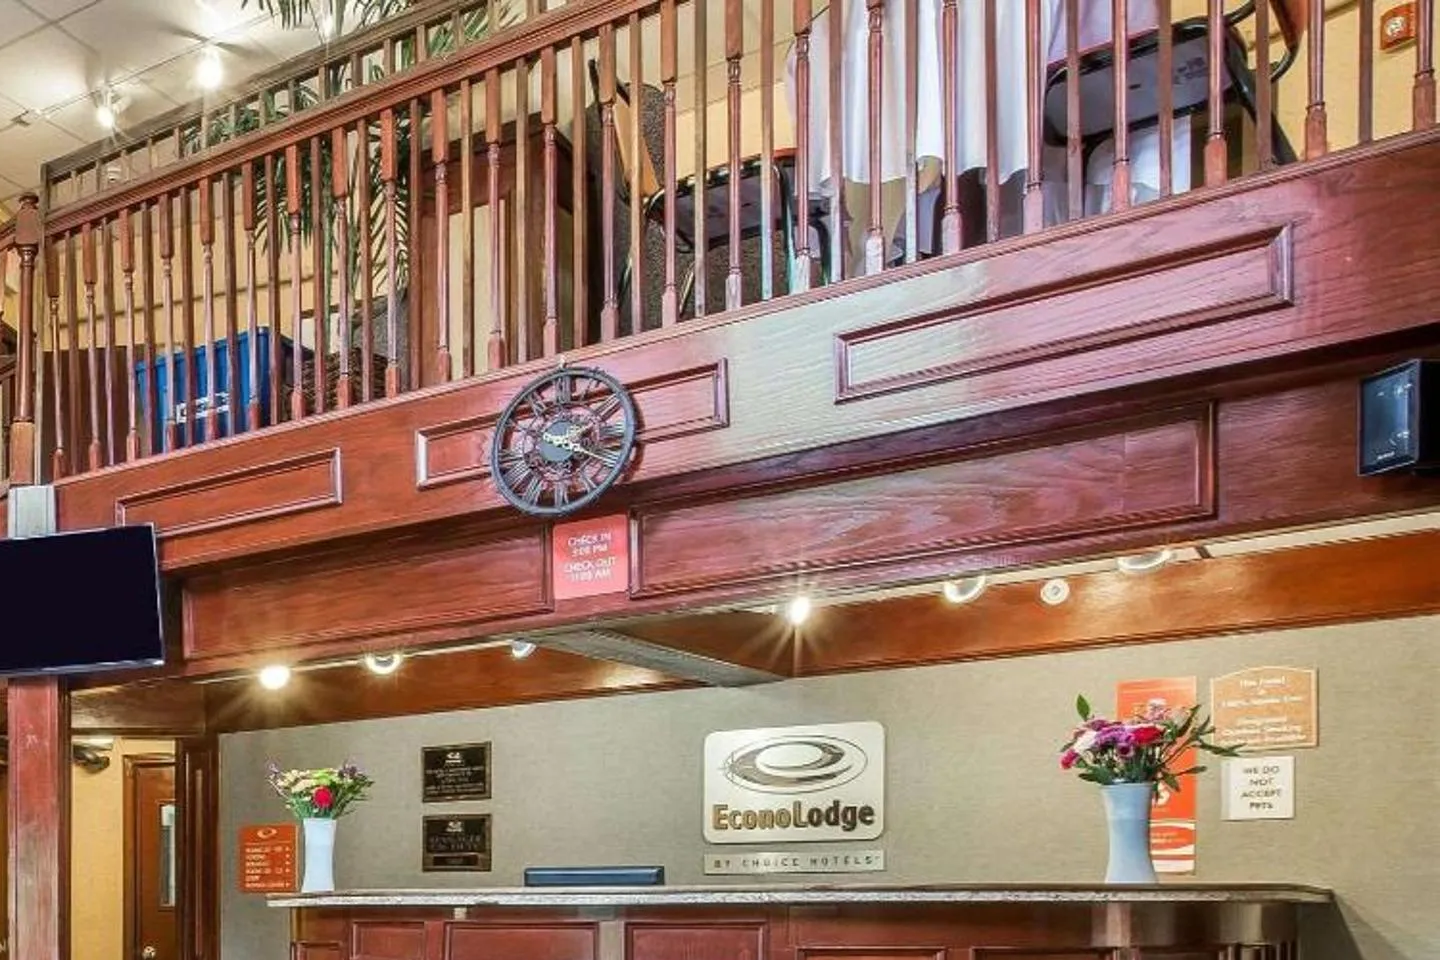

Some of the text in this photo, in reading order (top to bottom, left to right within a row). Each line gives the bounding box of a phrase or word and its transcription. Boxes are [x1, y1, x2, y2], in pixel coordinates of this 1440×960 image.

[568, 532, 612, 548] CHECK IN
[564, 556, 617, 573] CHECK OUT
[594, 568, 611, 579] AM
[1243, 765, 1280, 775] WE DO
[1249, 777, 1274, 786] NOT
[1240, 788, 1282, 798] ACCEPT
[712, 800, 875, 833] EconoLodge
[713, 855, 873, 869] BY CHOICE HOTELS
